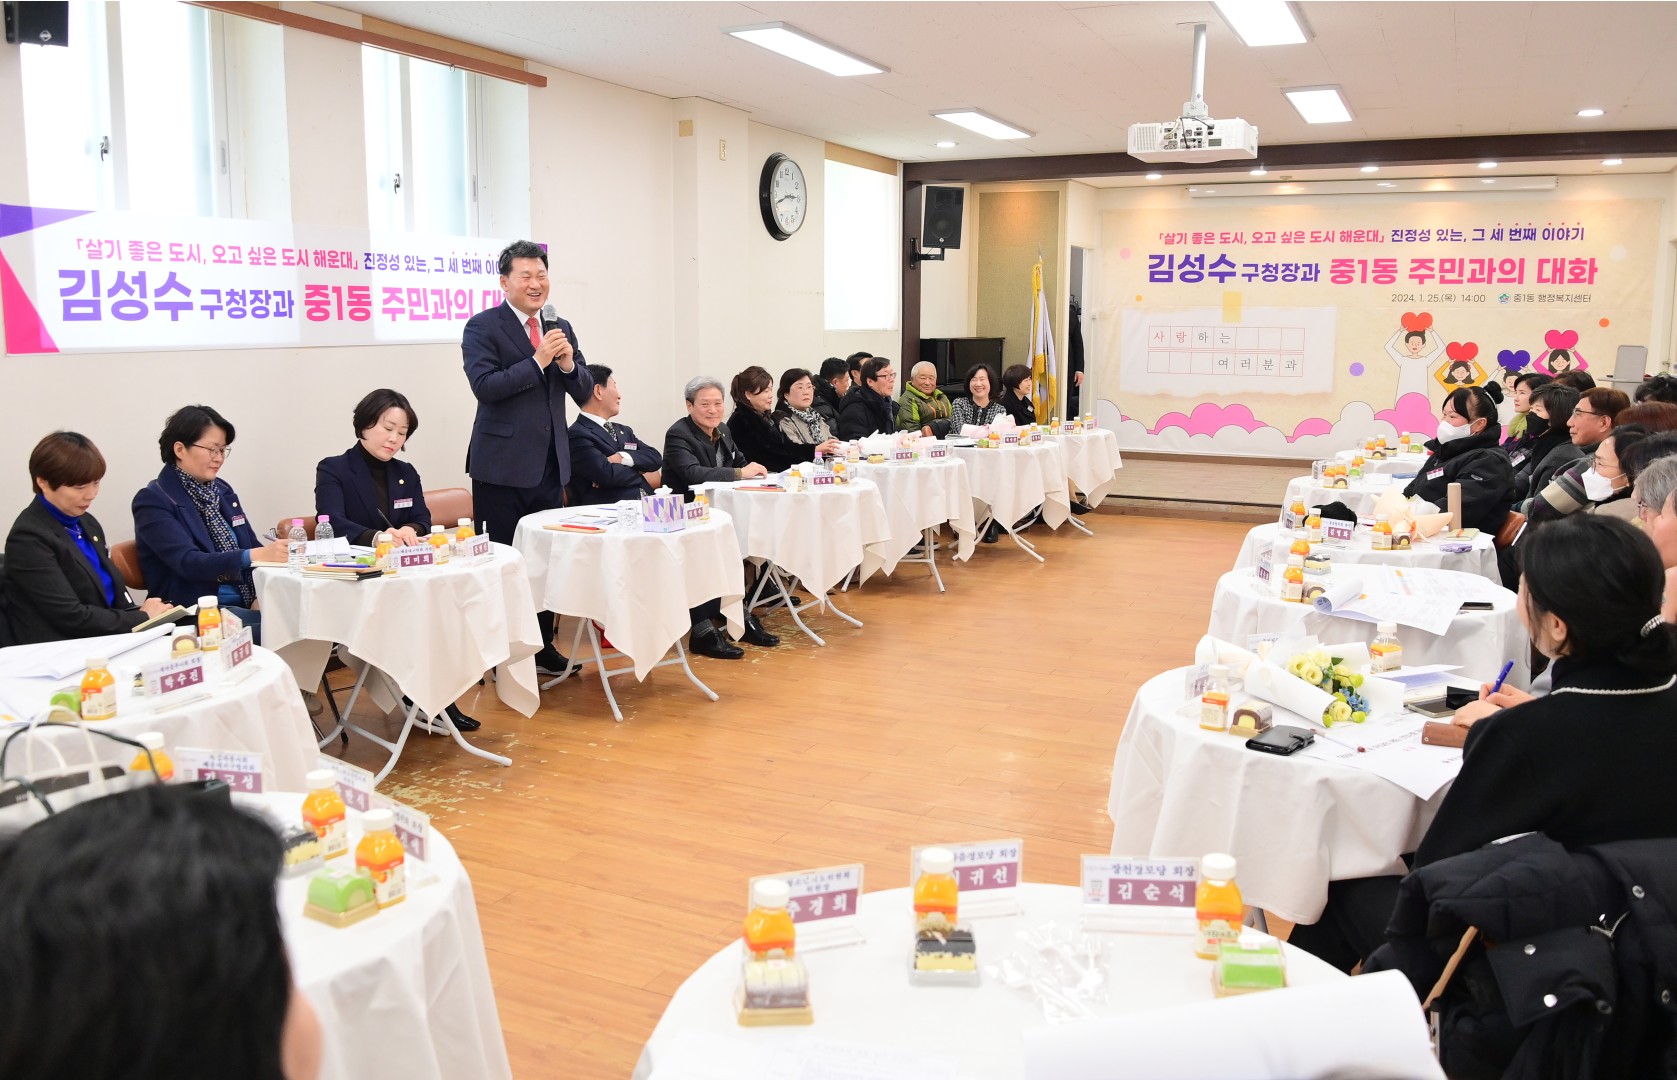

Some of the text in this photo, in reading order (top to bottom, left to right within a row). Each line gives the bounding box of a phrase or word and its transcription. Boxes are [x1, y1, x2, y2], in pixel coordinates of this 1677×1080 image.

[1191, 231, 1216, 245] 좋은
[1219, 231, 1247, 245] 도시,
[1251, 231, 1276, 244] 오고
[1280, 230, 1306, 244] 싶은
[1309, 230, 1336, 244] 도시
[1391, 228, 1431, 243] 진정성
[1436, 228, 1467, 243] 있는,
[1471, 228, 1486, 242] 그
[1489, 227, 1504, 242] 세
[1508, 227, 1537, 242] 번째
[1541, 227, 1585, 241] 이야기
[128, 240, 162, 262] 좋은
[169, 242, 206, 265] 도시,
[212, 244, 243, 264] 오고
[248, 246, 277, 266] 싶은
[282, 248, 309, 267] 도시
[364, 252, 400, 271] 진정성
[404, 255, 431, 273] 있는,
[434, 257, 445, 273] 그
[448, 257, 458, 274] 세
[461, 257, 482, 275] 번째
[1148, 253, 1599, 285] 김성수 구청장과 중1동 주민과의 대화
[58, 269, 194, 321] 김성수
[200, 288, 295, 320] 구청장과
[304, 284, 372, 322] 중1동
[381, 286, 474, 321] 주민과의
[1461, 294, 1486, 302] 14:00
[1513, 293, 1535, 303] 중1동
[1537, 293, 1592, 303] 행정복지센터
[1117, 881, 1185, 903] 김순석
